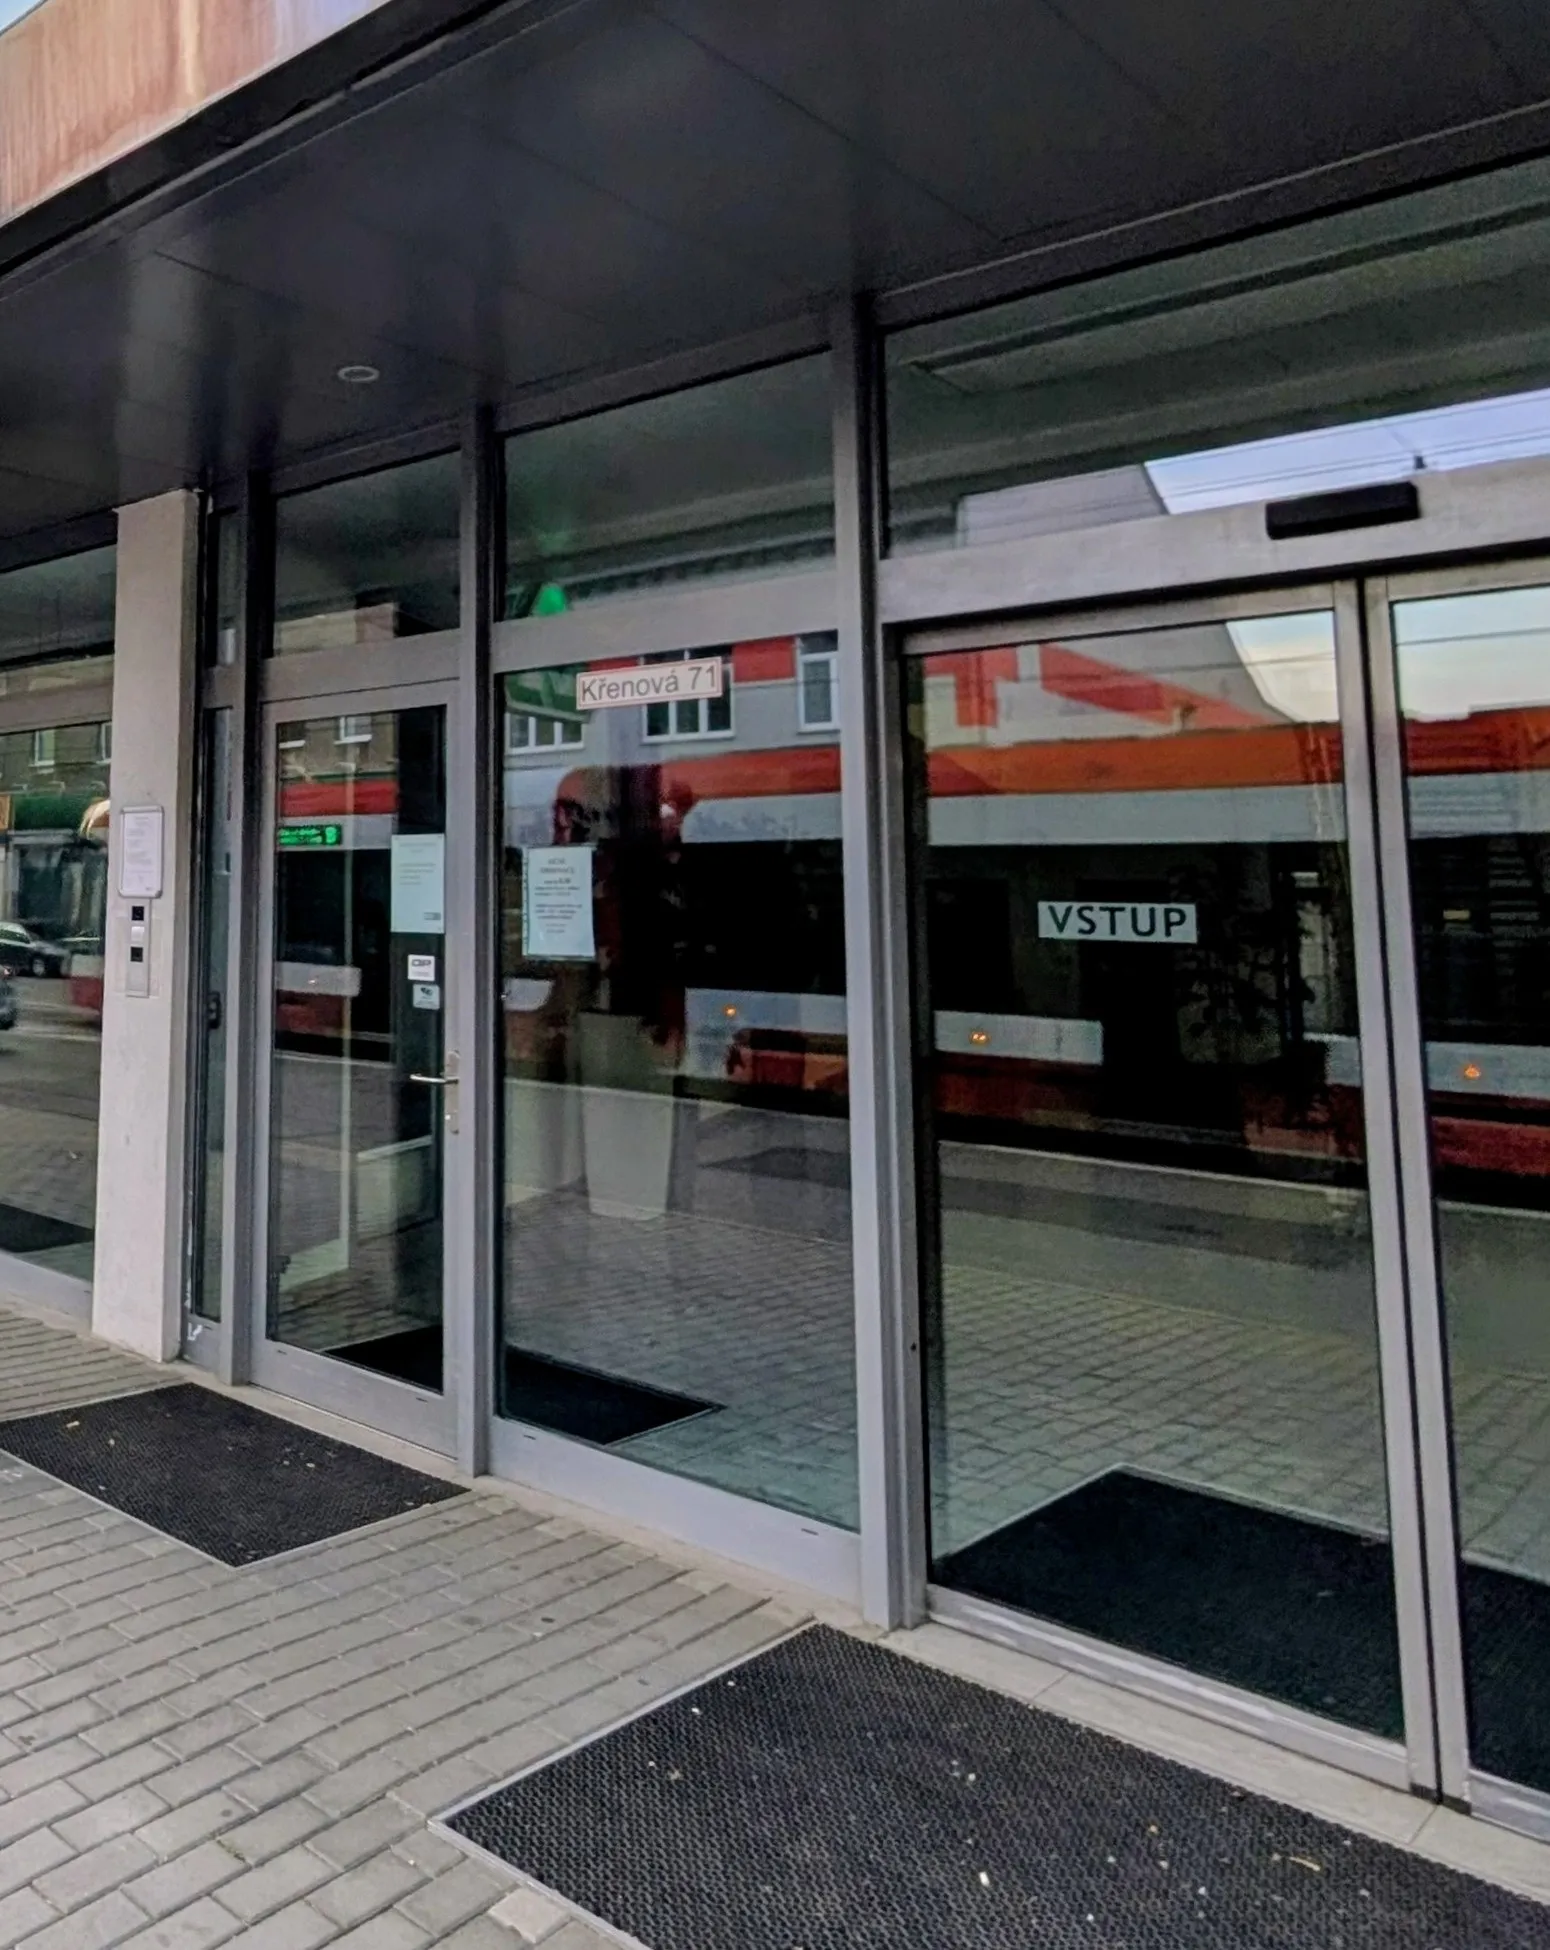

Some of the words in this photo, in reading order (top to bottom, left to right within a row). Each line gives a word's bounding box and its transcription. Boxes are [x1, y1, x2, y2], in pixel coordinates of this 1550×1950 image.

[582, 669, 679, 701] Křenová
[688, 665, 715, 690] 71
[1048, 905, 1186, 937] VSTUP
